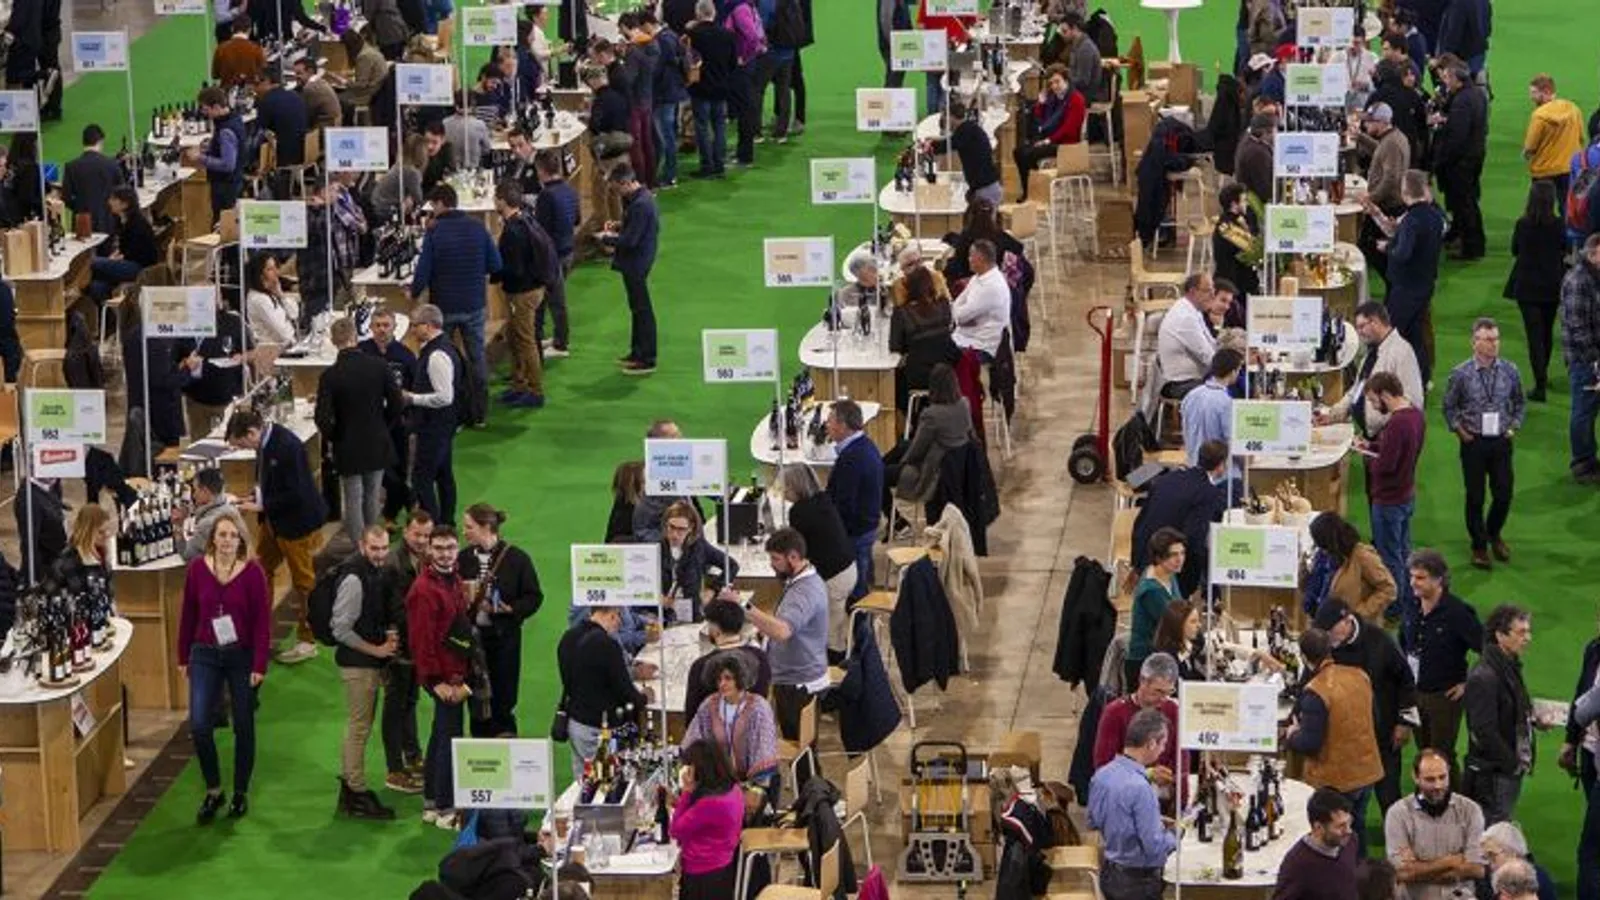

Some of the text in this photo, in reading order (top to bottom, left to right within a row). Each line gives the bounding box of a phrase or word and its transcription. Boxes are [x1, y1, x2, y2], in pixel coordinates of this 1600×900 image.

[717, 368, 734, 378] 563
[42, 429, 58, 440] 562
[1245, 441, 1263, 451] 496
[660, 481, 676, 491] 561
[1227, 569, 1245, 580] 494
[587, 589, 605, 601] 559
[1199, 732, 1218, 744] 492
[471, 790, 493, 803] 557
